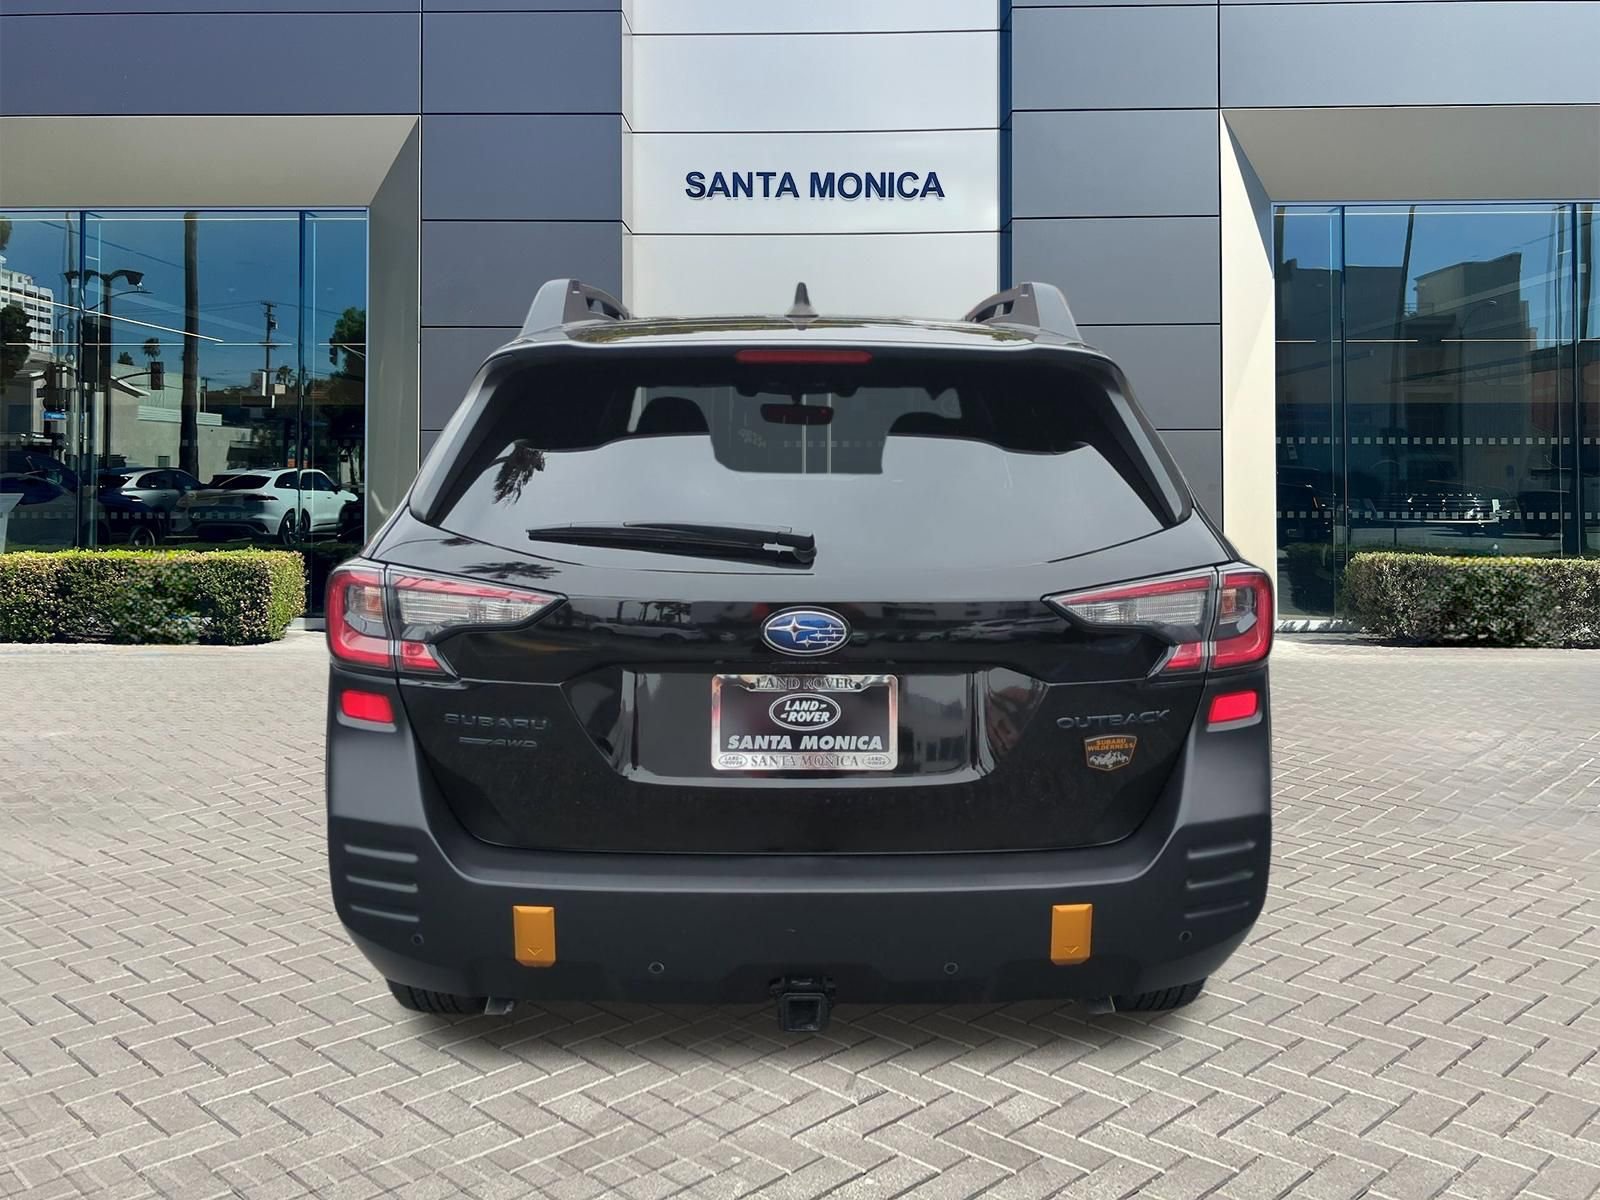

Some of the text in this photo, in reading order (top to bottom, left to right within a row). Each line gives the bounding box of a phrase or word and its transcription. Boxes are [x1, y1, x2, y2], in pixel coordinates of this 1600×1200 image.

[685, 171, 945, 199] SANTA MONICA
[756, 677, 854, 690] LAND ROVER
[444, 713, 548, 730] SUBARU
[787, 711, 830, 722] ROVER
[1056, 709, 1170, 728] OUTBACK
[727, 735, 883, 750] SANTA MONICA
[751, 755, 859, 768] SANTA MONICA
